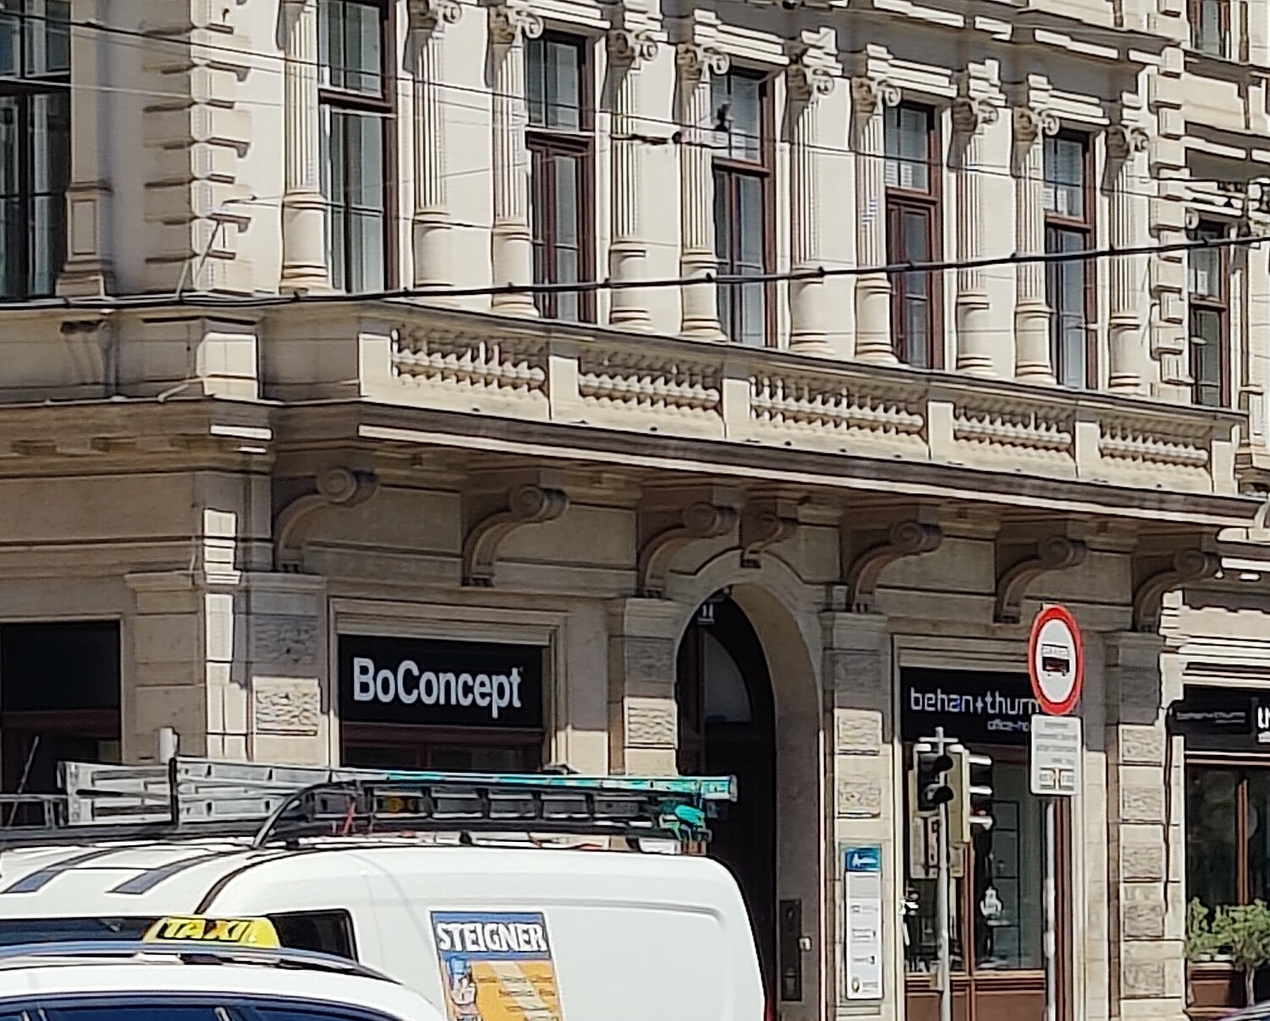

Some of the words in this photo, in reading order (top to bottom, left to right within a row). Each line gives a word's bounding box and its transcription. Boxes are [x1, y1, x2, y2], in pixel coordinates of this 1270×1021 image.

[353, 656, 522, 719] BoConcept
[156, 920, 251, 942] TAXI
[437, 922, 548, 952] STEIGNER
